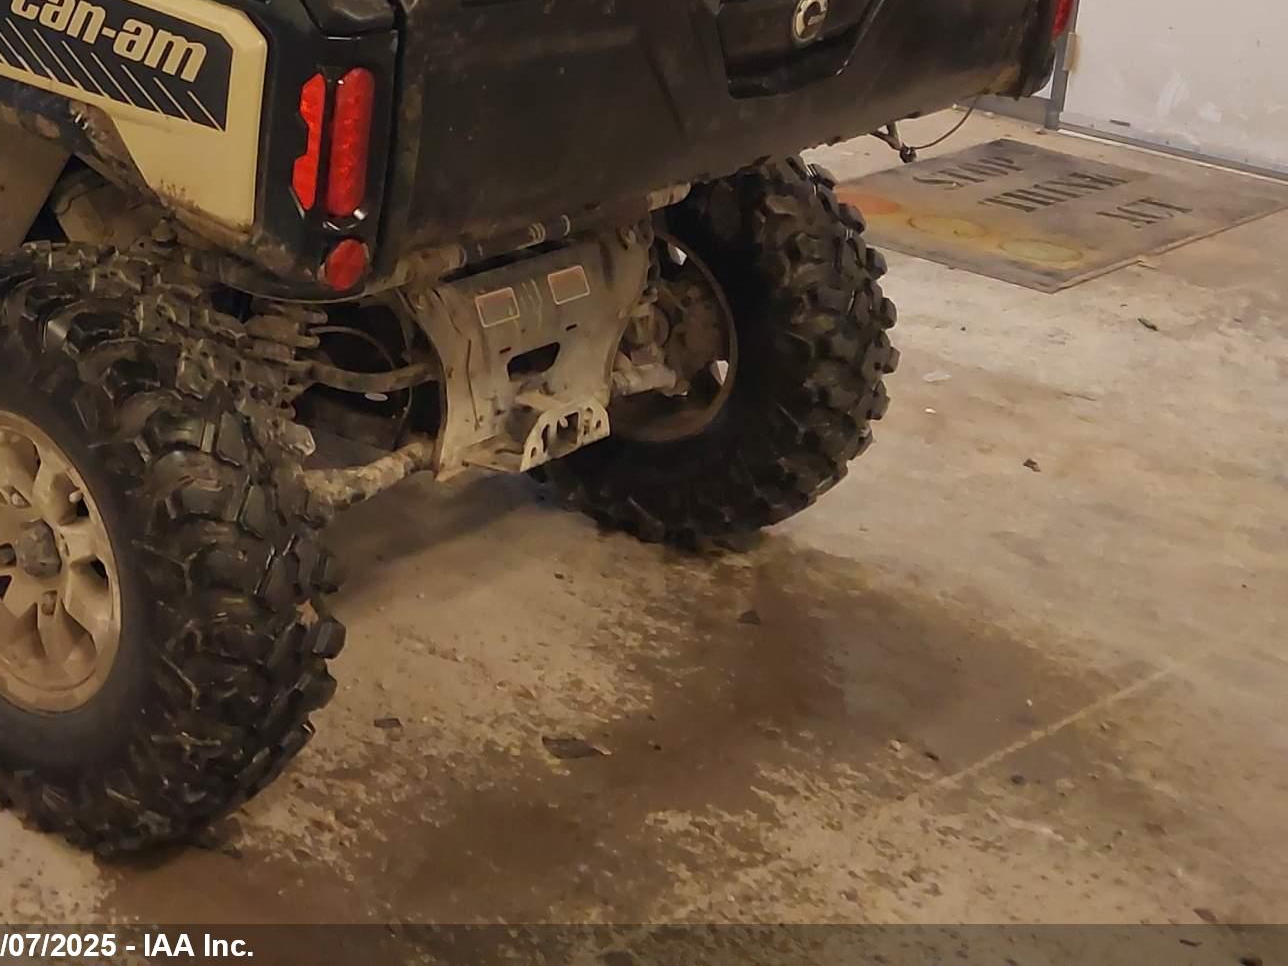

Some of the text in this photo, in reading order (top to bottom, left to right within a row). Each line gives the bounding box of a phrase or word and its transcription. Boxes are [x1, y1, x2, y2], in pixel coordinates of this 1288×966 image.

[912, 156, 1024, 191] STOP
[977, 171, 1129, 213] THINK
[1095, 197, 1193, 228] ACT
